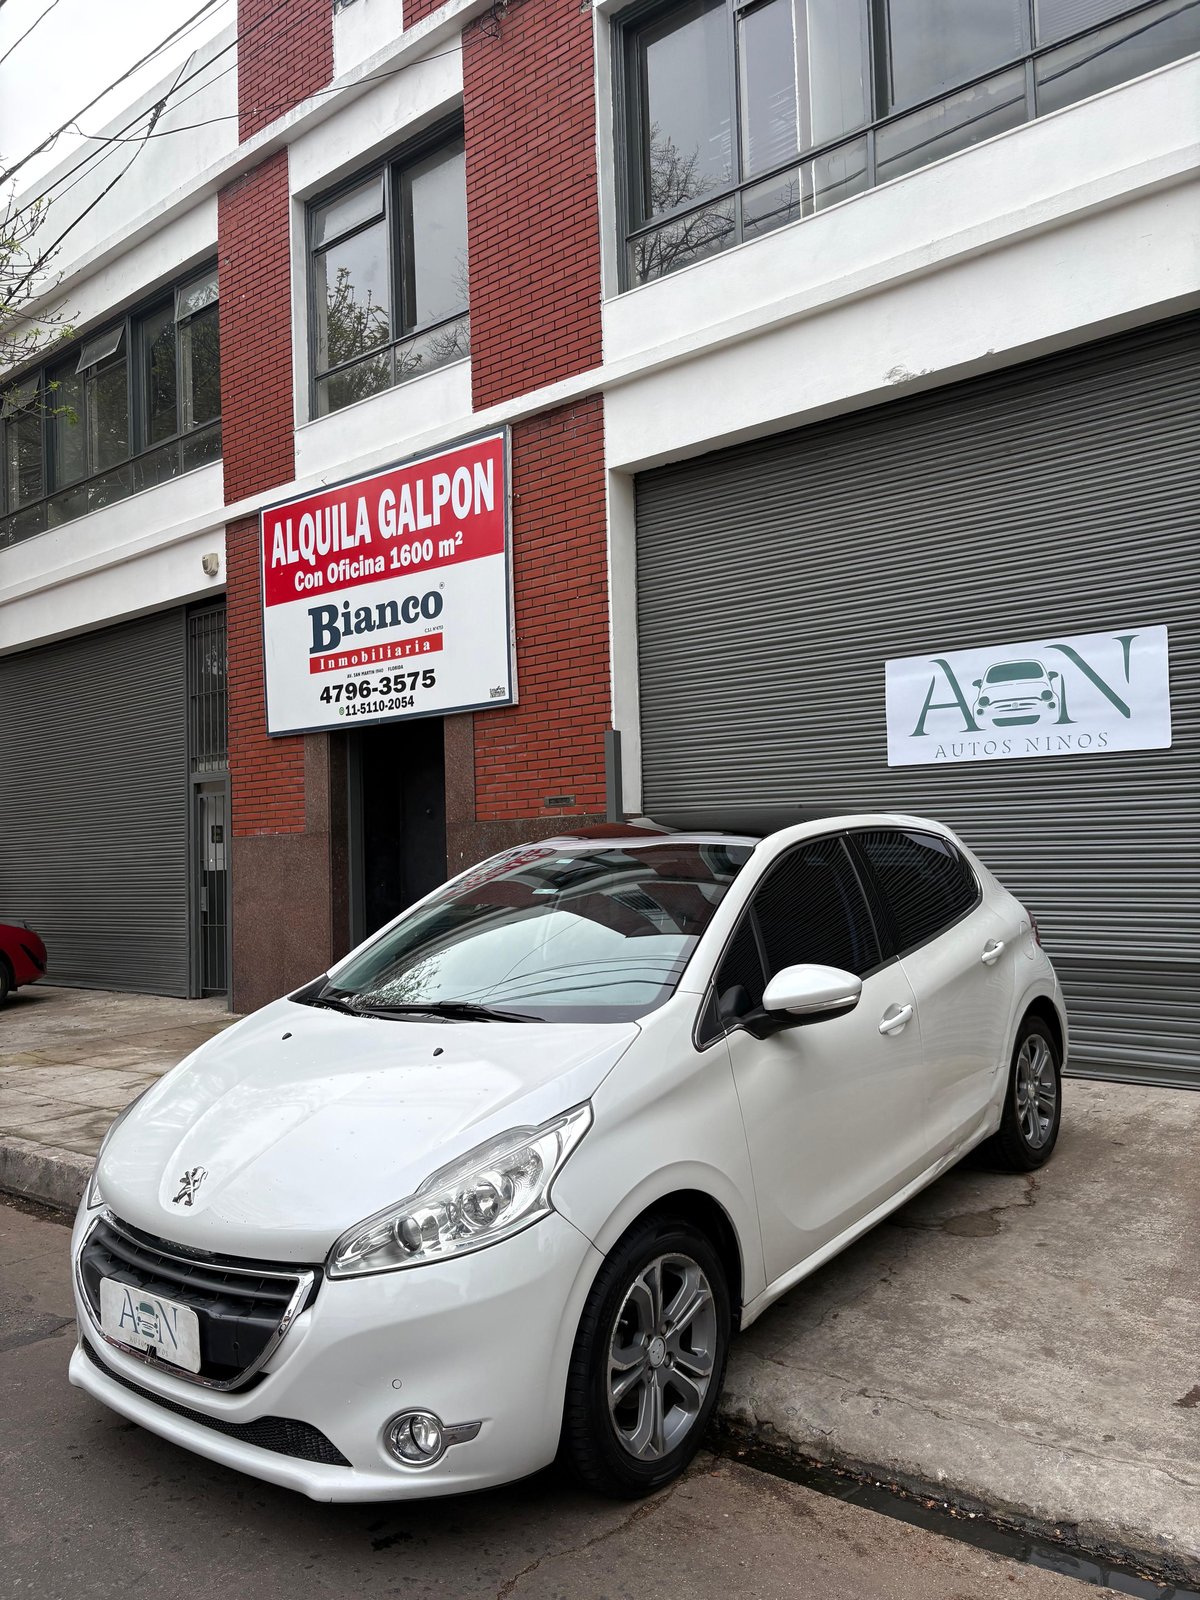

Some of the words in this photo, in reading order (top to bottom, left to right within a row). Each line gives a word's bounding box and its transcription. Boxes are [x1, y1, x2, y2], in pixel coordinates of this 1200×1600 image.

[271, 496, 372, 569] ALQUILA
[378, 458, 495, 539] GALPON
[294, 570, 324, 592] Con
[326, 554, 385, 584] Oficina
[390, 538, 434, 570] 1600
[308, 590, 443, 655] Bianco
[320, 640, 431, 670] Inmobiliaria
[387, 664, 404, 672] FLORIDA
[319, 668, 436, 704] 4796-3575
[345, 695, 415, 716] 11-5110-2054
[935, 738, 1012, 759] AUTOS
[1026, 732, 1109, 752] NINOS
